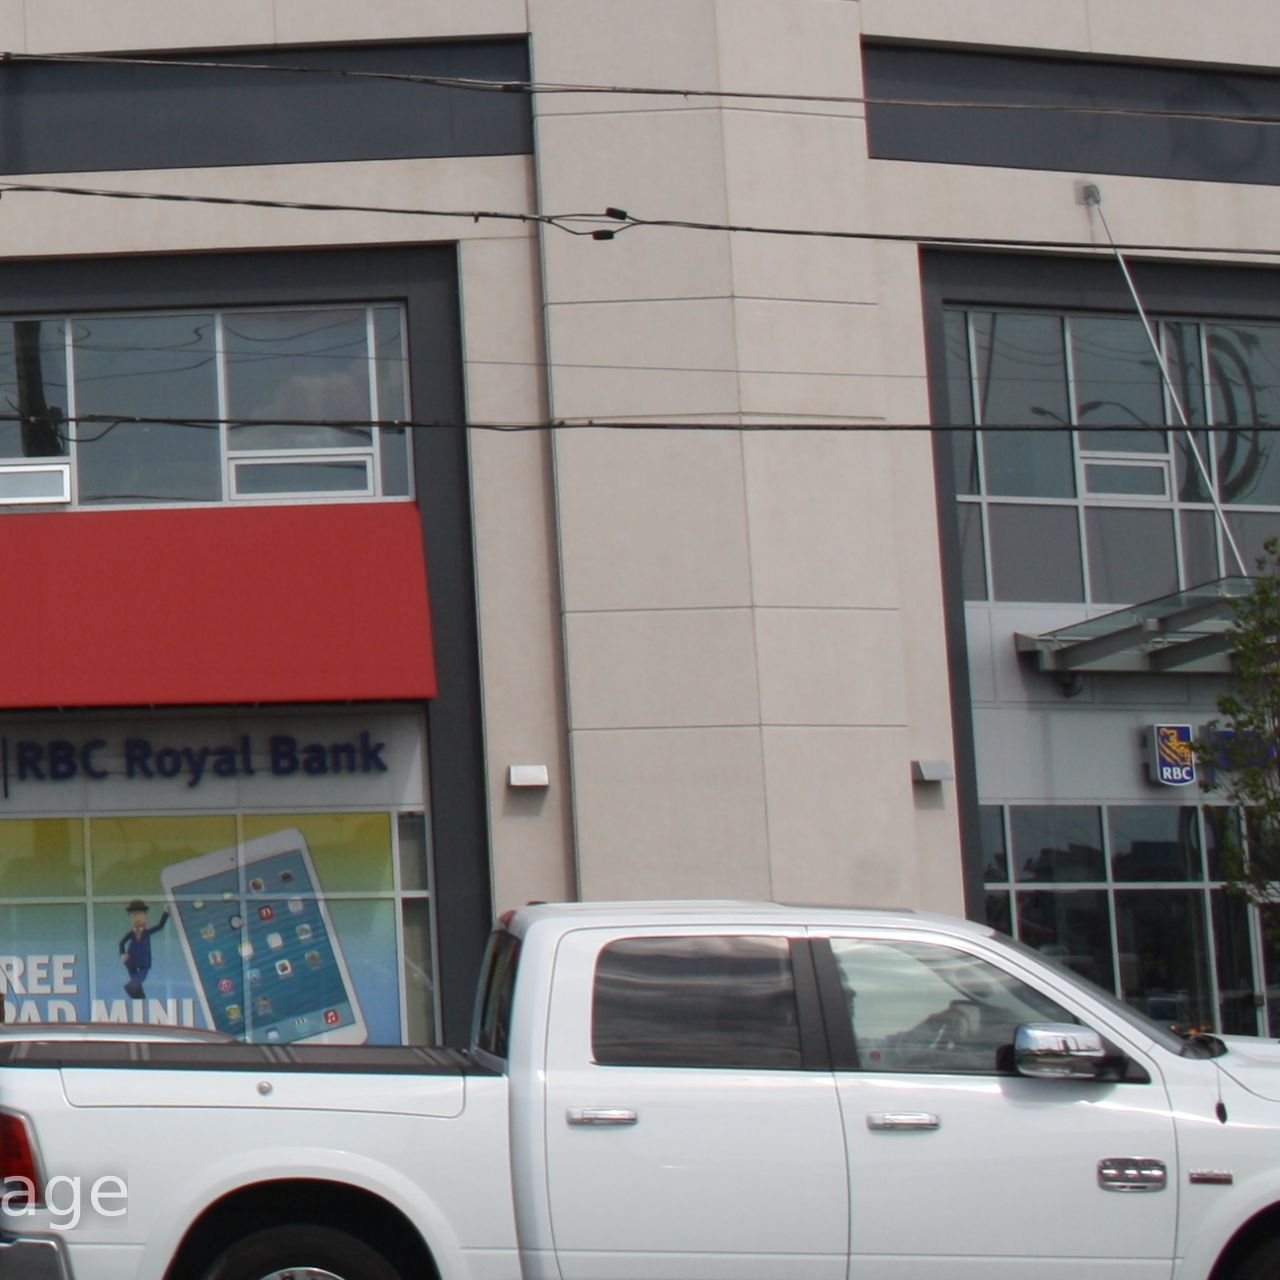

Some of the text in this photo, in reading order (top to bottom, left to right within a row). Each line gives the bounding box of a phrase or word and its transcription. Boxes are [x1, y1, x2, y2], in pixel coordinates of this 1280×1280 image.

[16, 731, 388, 788] RBC Royal Bank
[1162, 766, 1192, 780] RBC
[4, 998, 195, 1026] PAD MINI
